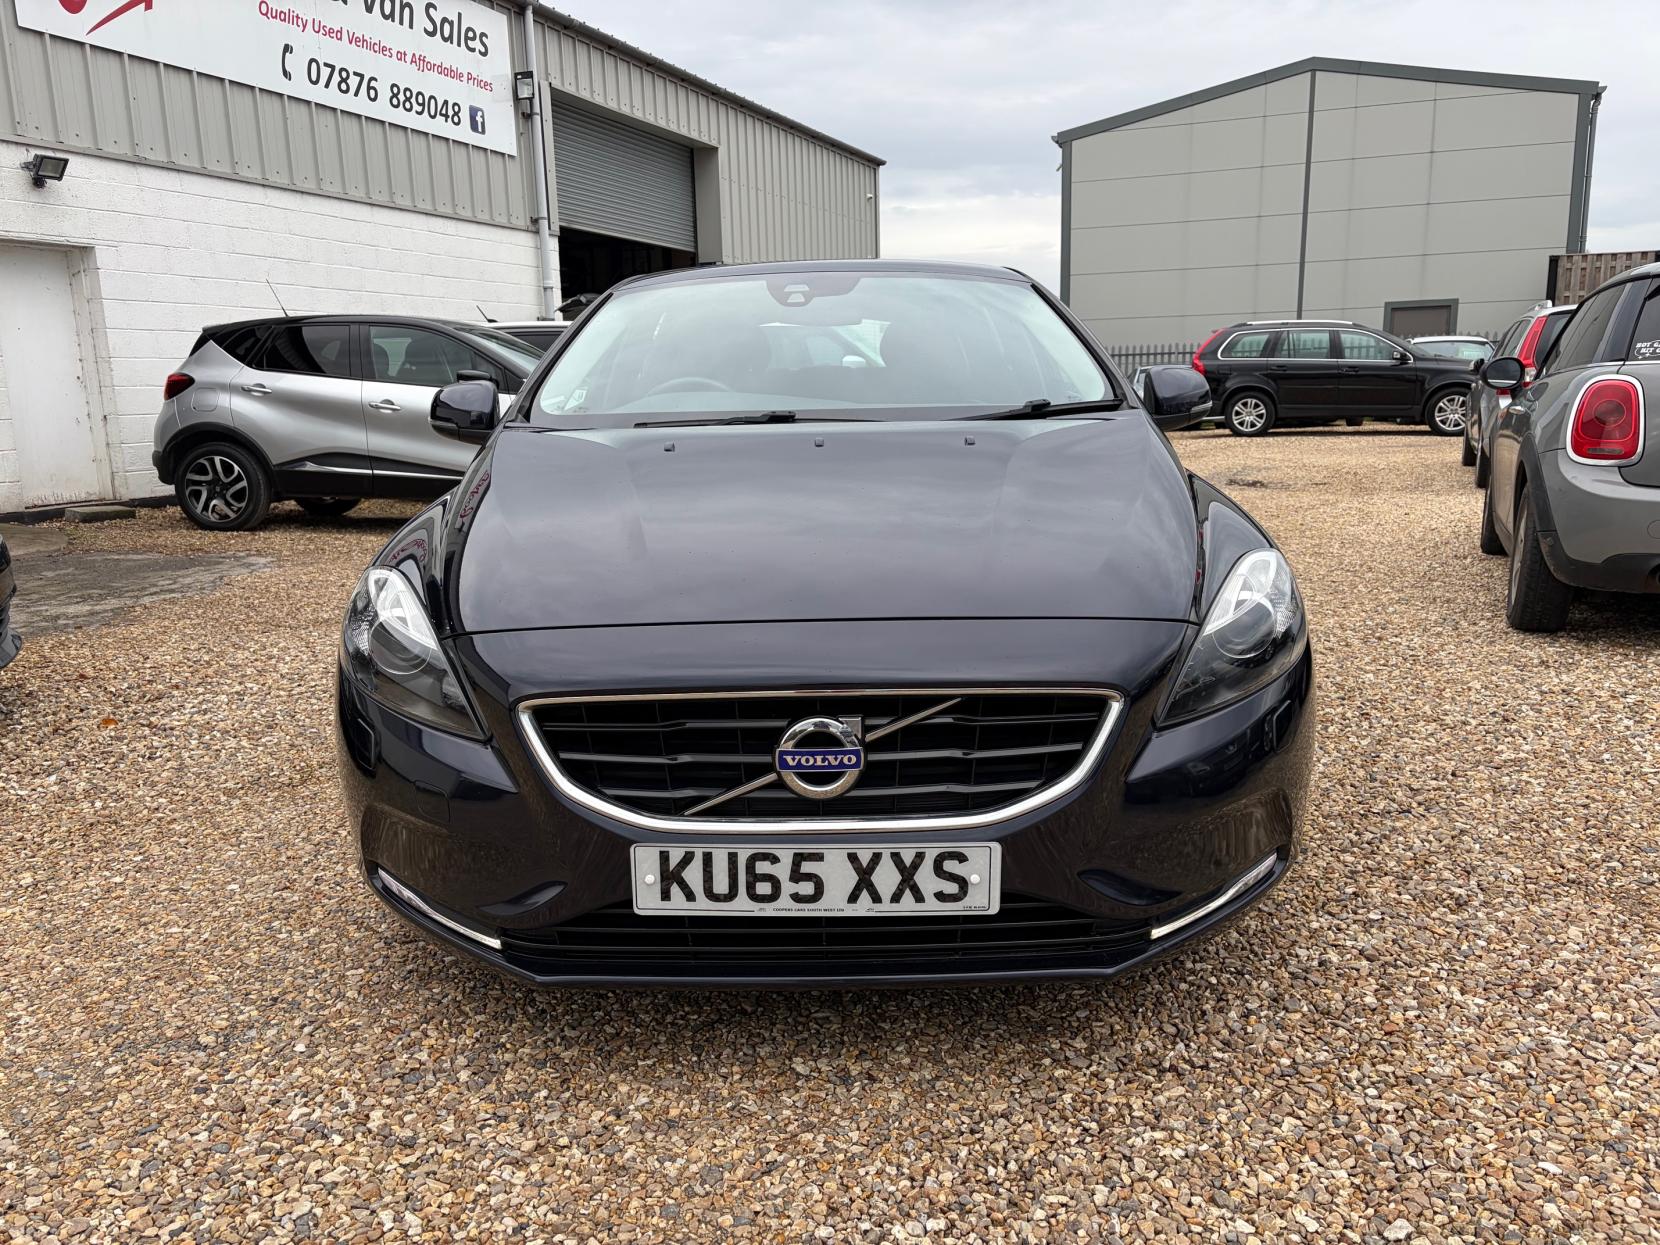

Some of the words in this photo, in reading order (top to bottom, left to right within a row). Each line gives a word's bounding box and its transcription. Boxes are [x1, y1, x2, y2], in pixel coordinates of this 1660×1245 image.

[258, 0, 308, 33] Quality
[311, 17, 343, 42] Used
[346, 29, 393, 59] Vehicles
[395, 48, 408, 64] at
[410, 52, 464, 83] Affordable
[466, 71, 494, 93] Prices
[423, 1, 489, 58] Sales
[306, 57, 379, 103] 07876
[389, 82, 462, 127] 889048
[783, 754, 857, 767] VOLVO
[658, 850, 825, 904] KU65
[846, 850, 970, 905] XXS
